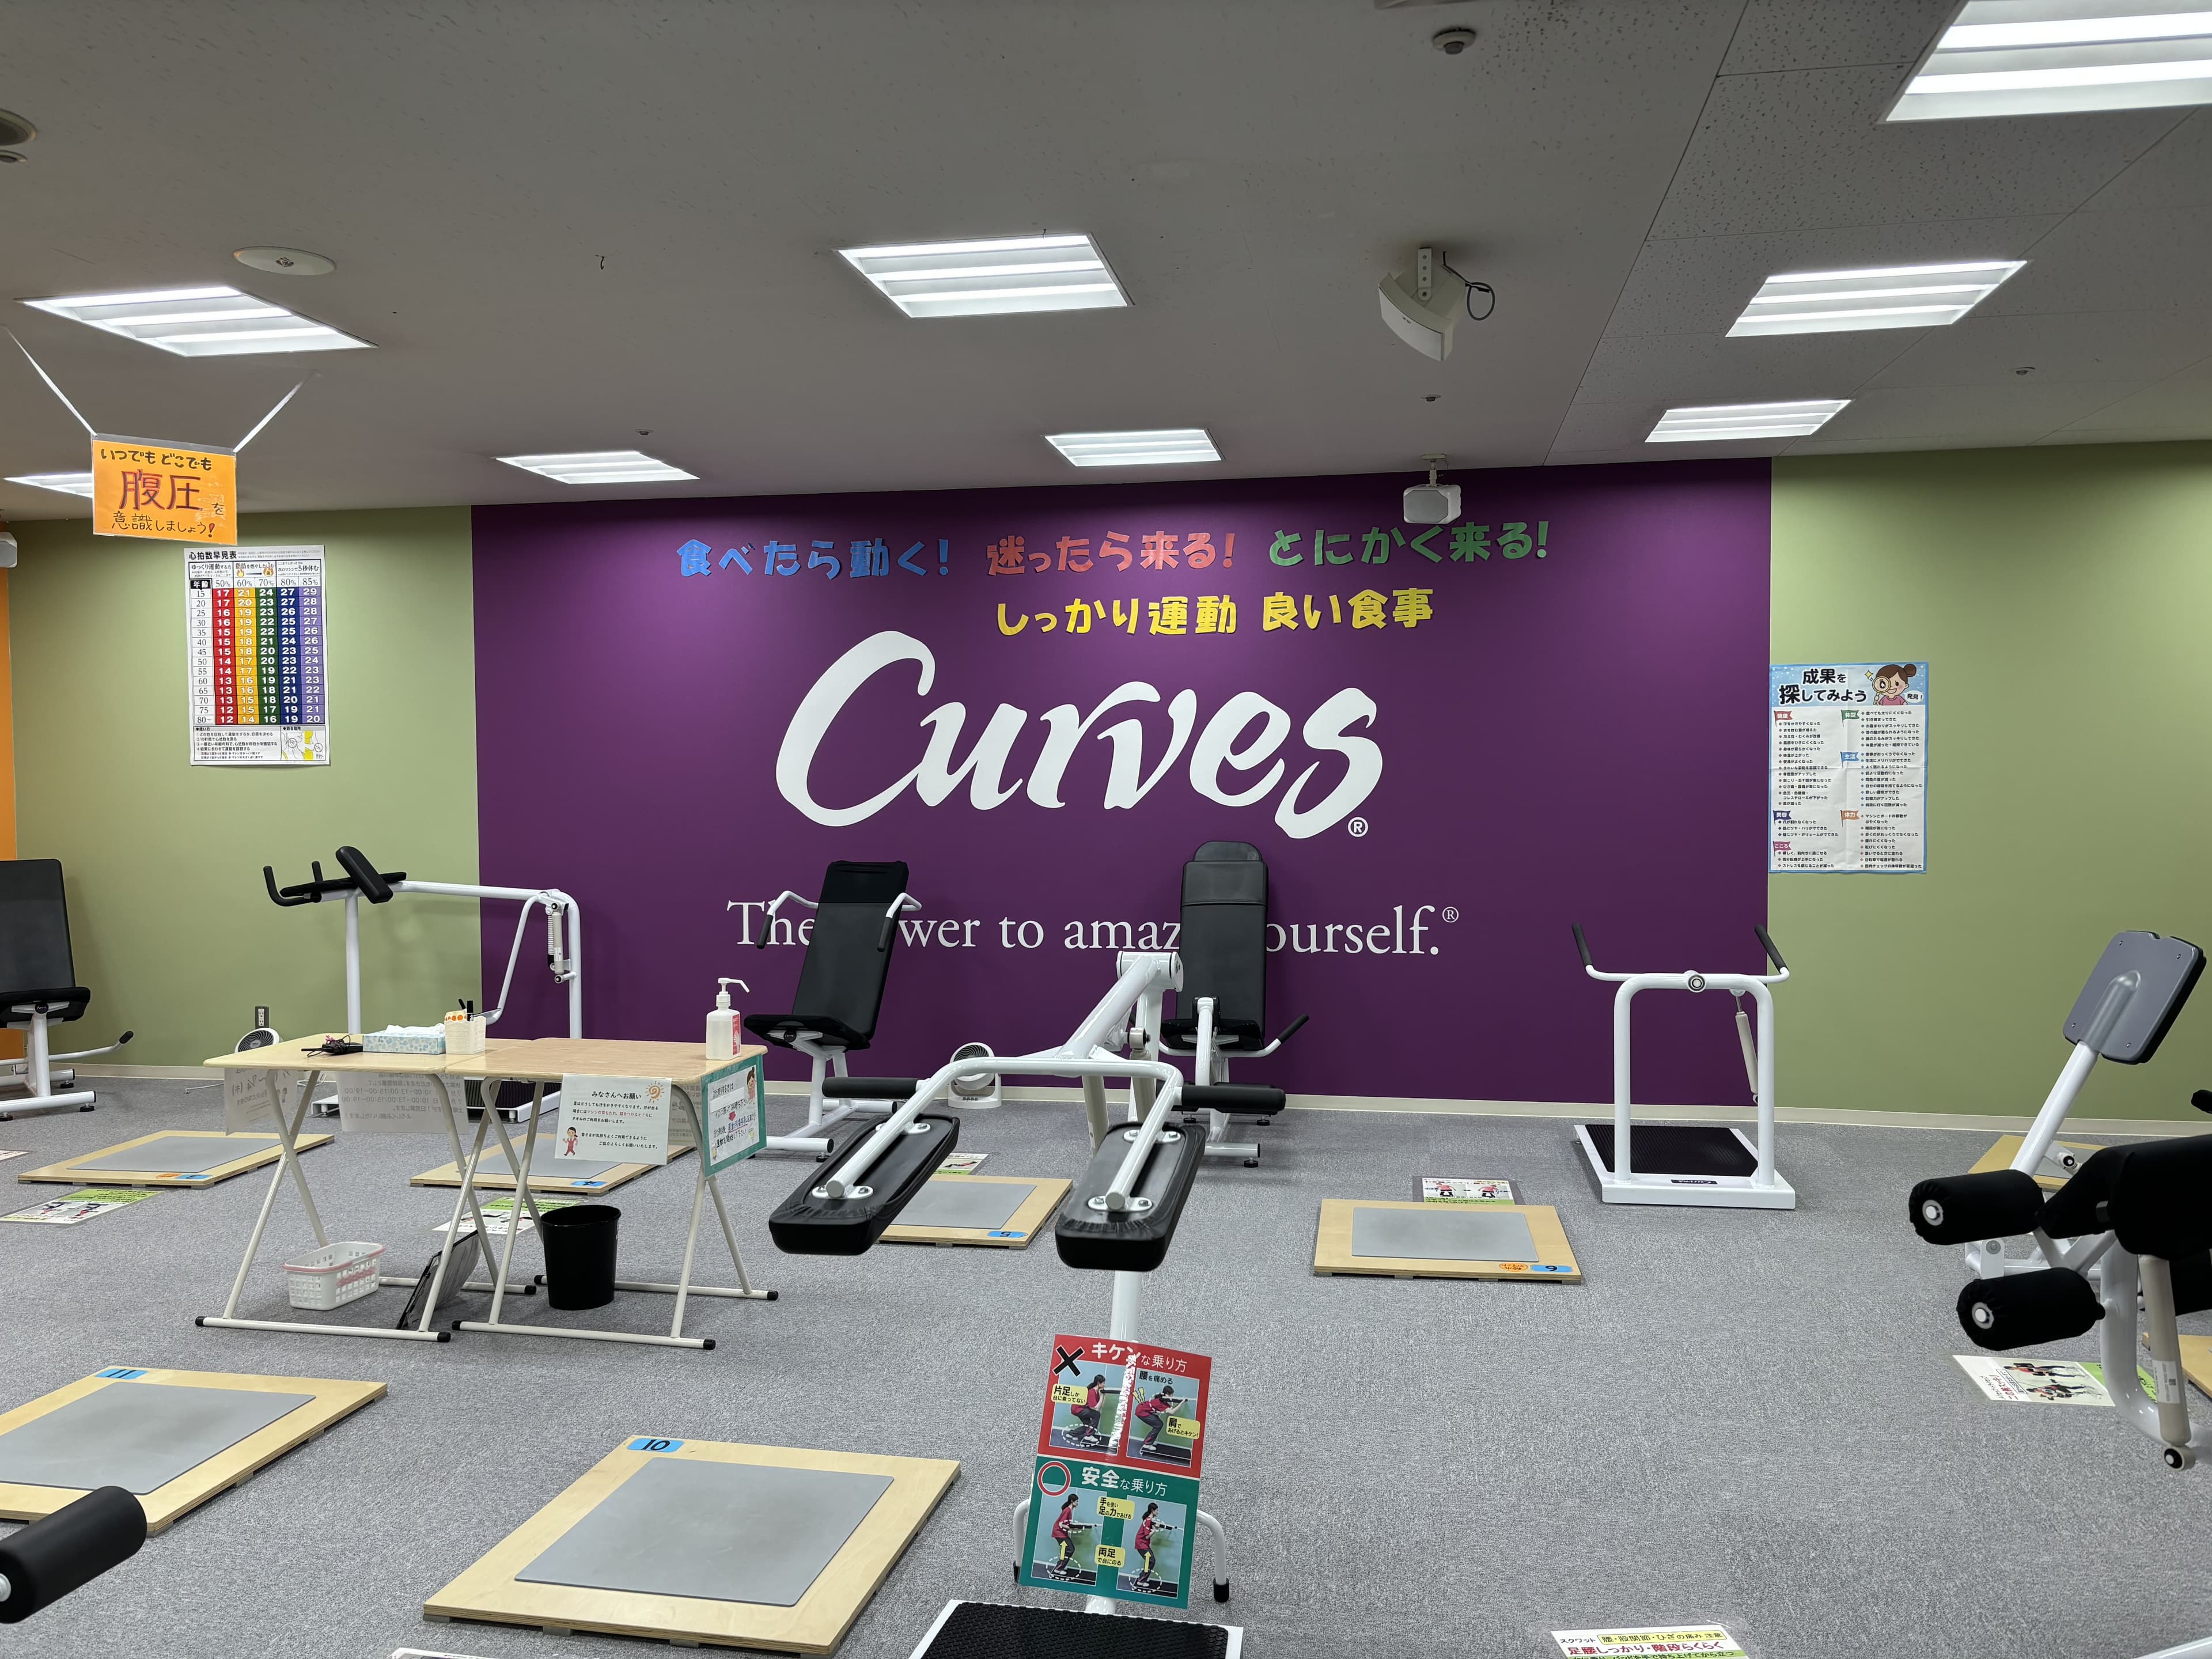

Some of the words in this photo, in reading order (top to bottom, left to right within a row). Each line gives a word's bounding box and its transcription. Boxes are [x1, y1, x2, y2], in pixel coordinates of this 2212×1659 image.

[101, 449, 156, 464] いつでも
[161, 453, 212, 471] どこでも
[119, 469, 203, 510] 腹圧
[212, 502, 224, 516] を
[189, 551, 237, 560] 心拍数早見表
[676, 538, 949, 580] 食べたら動く！
[987, 531, 1236, 575] 迷ったら来る！
[1269, 521, 1550, 566] とにかく来る！
[259, 578, 274, 586] 70%
[997, 596, 1237, 635] しっかり運動
[1262, 587, 1434, 631] 良い食事
[1802, 668, 1846, 684] 成果を
[1779, 684, 1867, 704] 探してみよう
[775, 630, 1383, 839] Curves
[897, 918, 981, 948] wer
[999, 916, 1044, 949] to
[1063, 920, 1180, 950] amaz
[592, 1091, 642, 1100] みなさんへお願い
[1091, 1342, 1188, 1373] キケンな乗り方
[1139, 1370, 1173, 1385] 腰を痛める
[1054, 1385, 1080, 1397] 片足しか
[1052, 1395, 1086, 1404] 台に乗ってない
[1168, 1418, 1181, 1428] 肩で
[642, 1439, 671, 1451] 10
[1082, 1466, 1168, 1497] 安全な乗り方
[1099, 1498, 1119, 1508] 手を使い
[1098, 1506, 1132, 1520] 足の力であげる
[1098, 1548, 1116, 1558] 両足
[1097, 1557, 1122, 1566] で台にのる
[1568, 1642, 1724, 1655] 足腰しっかり・階段らくらく
